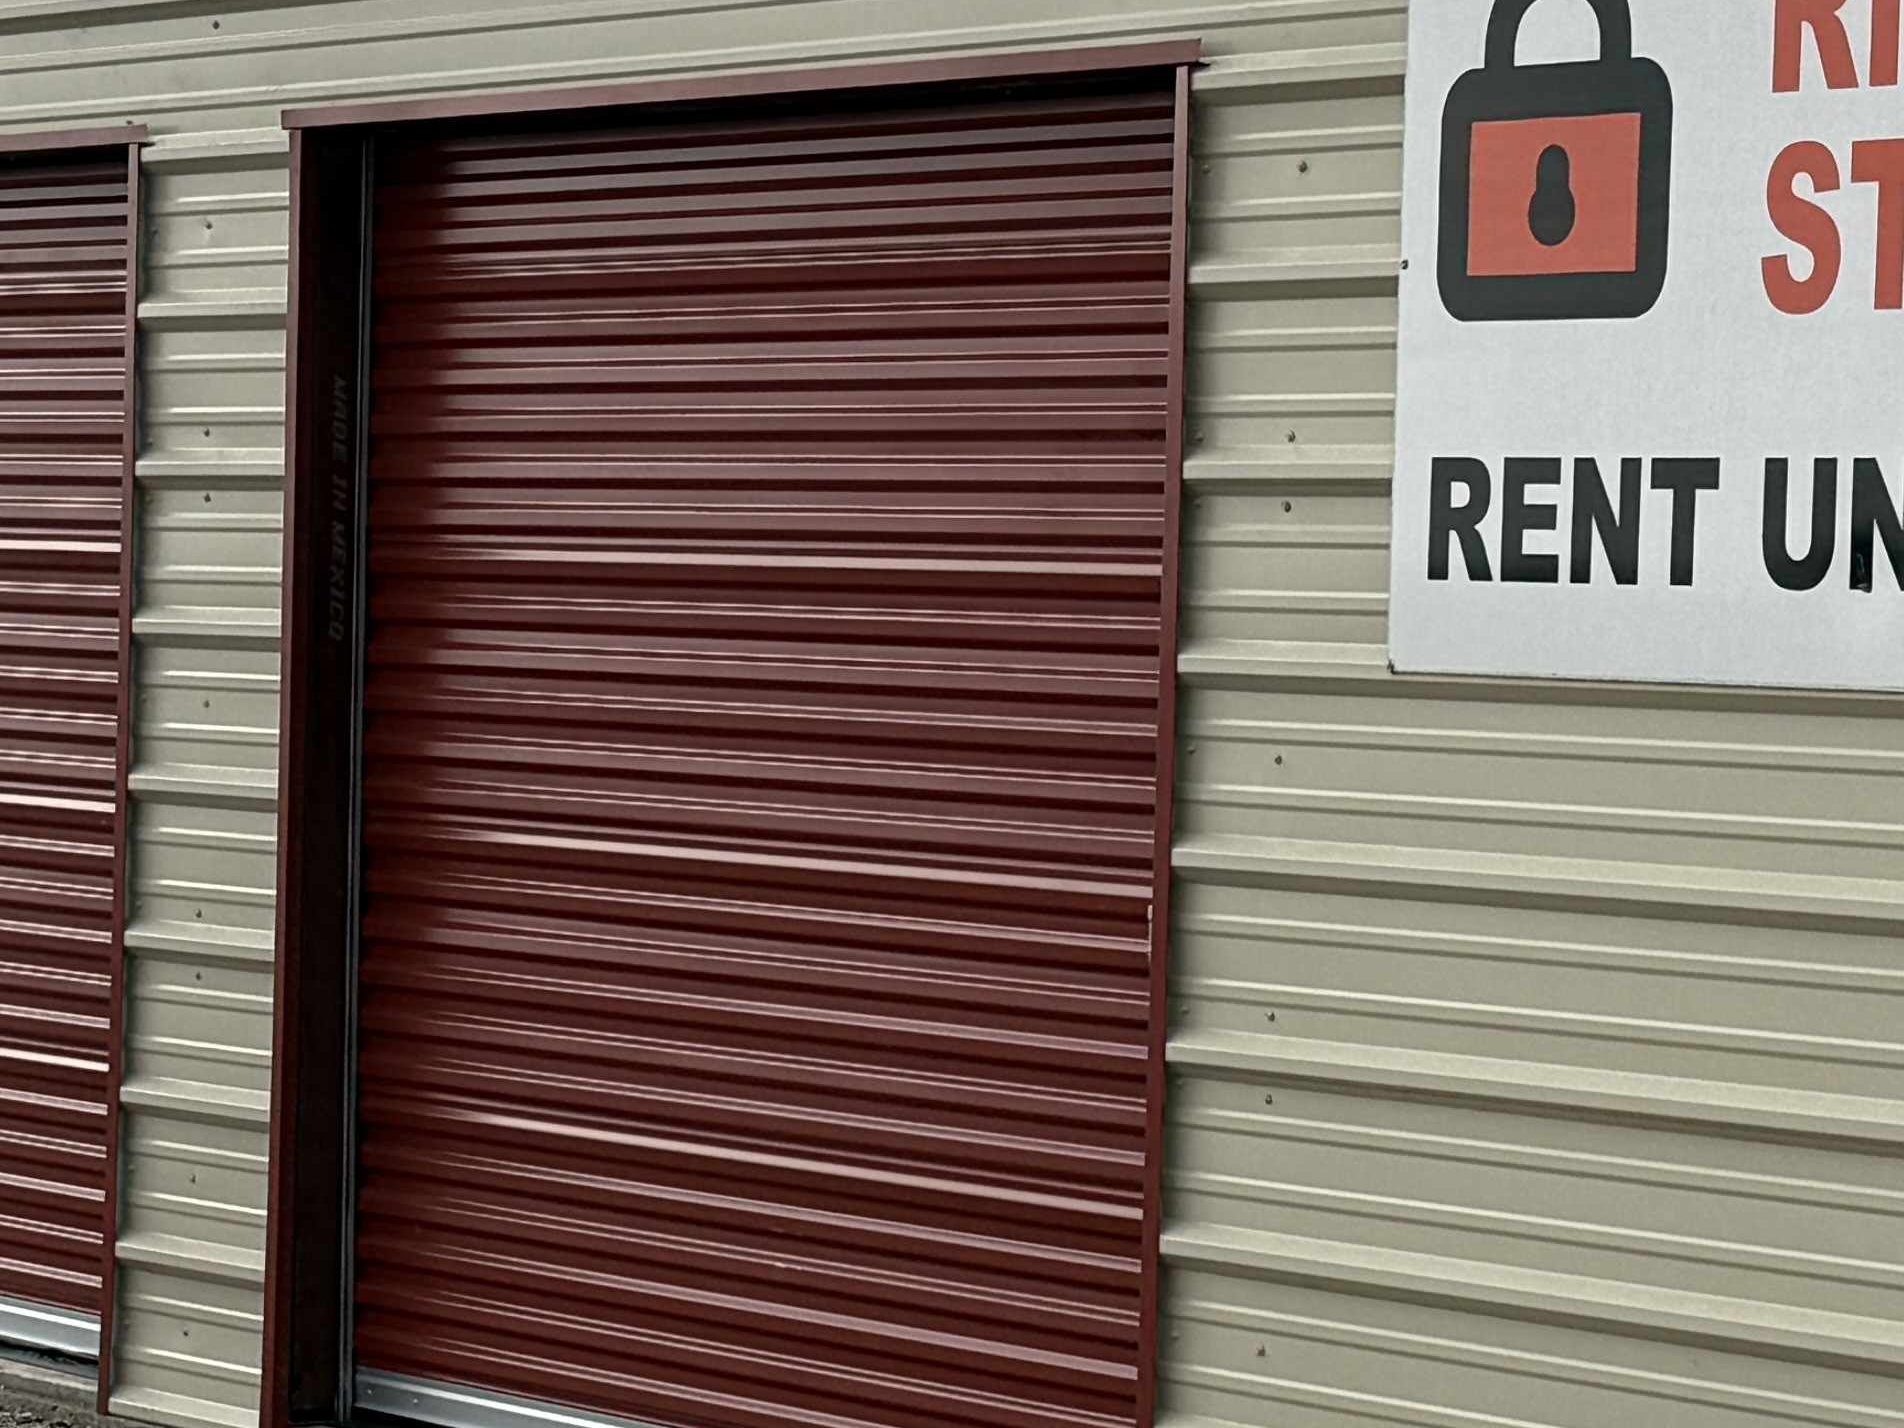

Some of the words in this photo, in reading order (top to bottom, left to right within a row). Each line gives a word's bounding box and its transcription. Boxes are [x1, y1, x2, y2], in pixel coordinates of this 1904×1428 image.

[332, 374, 348, 461] MADE
[331, 473, 348, 510] IN
[1426, 455, 1722, 589] RENT
[329, 520, 347, 641] MEXICO
